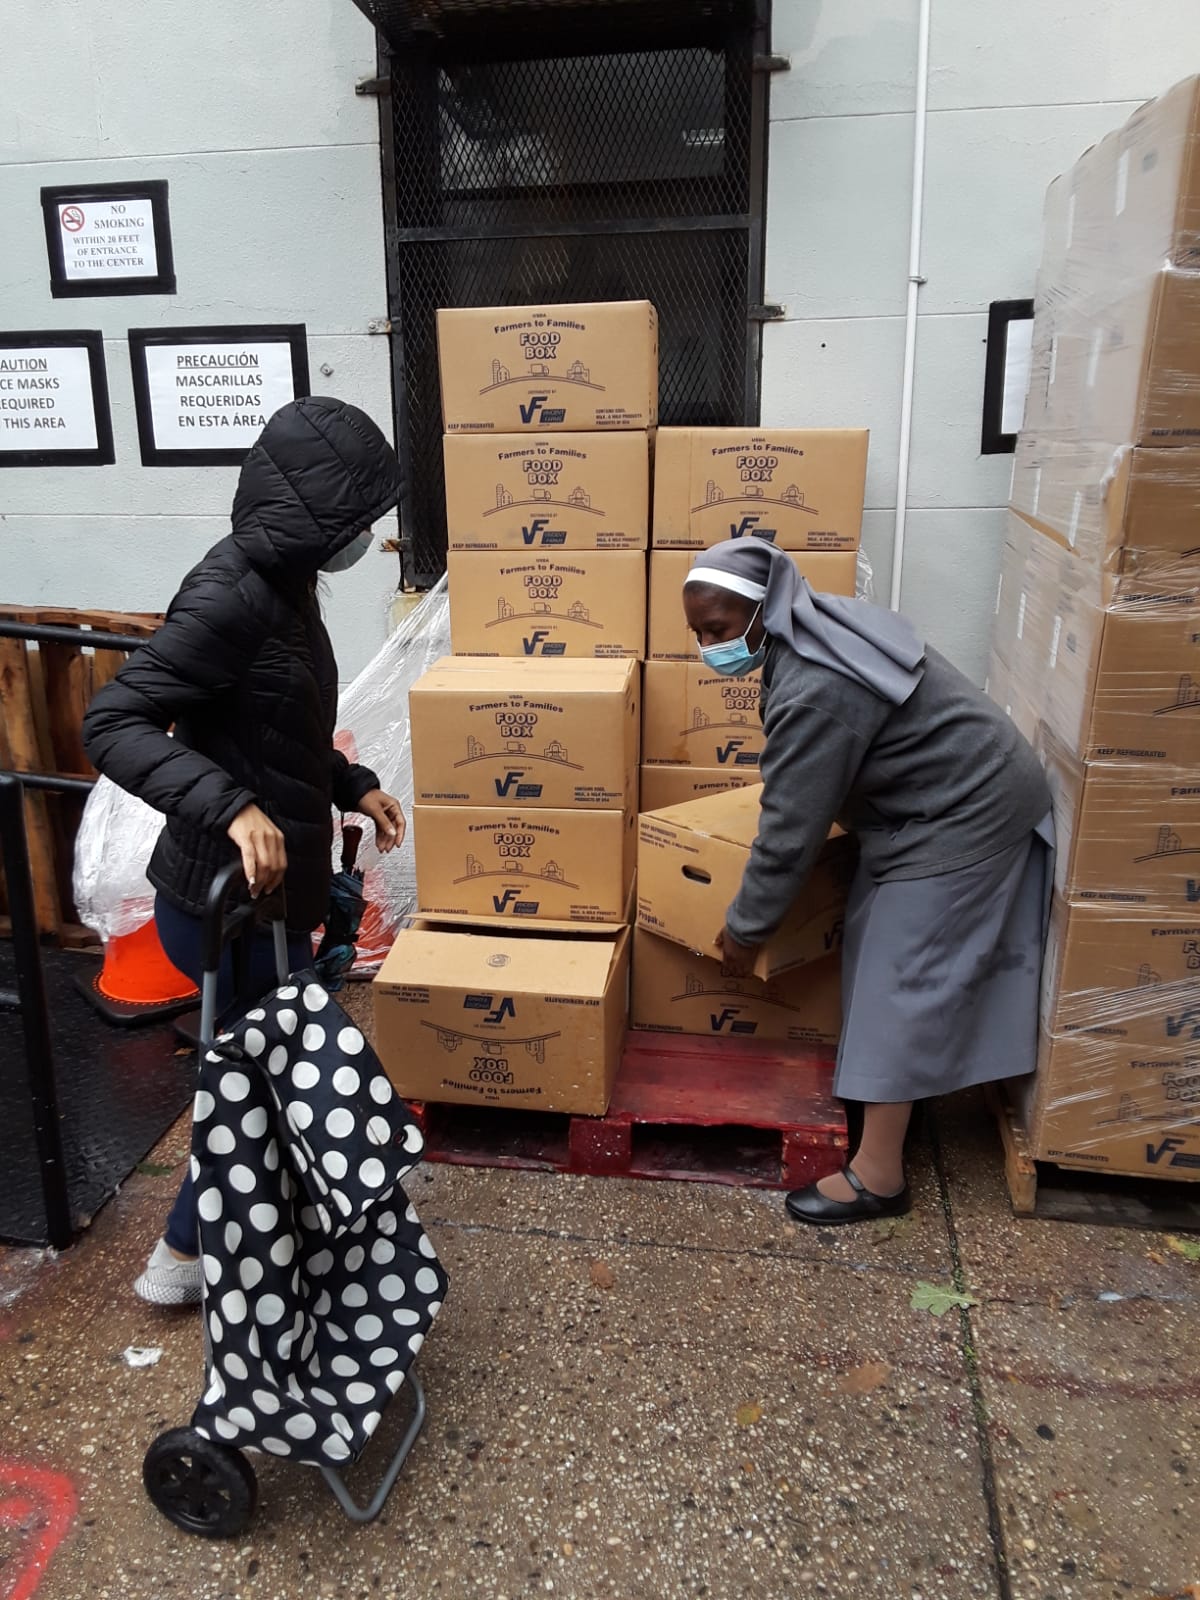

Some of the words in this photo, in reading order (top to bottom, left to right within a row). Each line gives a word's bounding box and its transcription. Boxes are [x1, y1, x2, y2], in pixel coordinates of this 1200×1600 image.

[110, 204, 126, 214] NO
[94, 218, 144, 229] SMOKING
[72, 236, 105, 245] WITHIN
[107, 235, 116, 244] 20
[118, 234, 140, 243] FEET
[77, 248, 88, 256] OF
[90, 246, 138, 256] ENTRANCE
[73, 260, 85, 268] TO
[86, 259, 105, 268] THE
[106, 258, 144, 267] CENTER
[494, 320, 532, 334] Farmers
[534, 319, 544, 328] to
[547, 318, 586, 331] Families
[519, 332, 561, 346] FOOD
[524, 346, 557, 360] BOX
[0, 358, 48, 372] AUTION
[176, 351, 259, 368] PRECAUCIÓN
[0, 379, 14, 390] CE
[17, 378, 60, 390] MASKS
[176, 374, 263, 387] MASCARILLAS
[0, 398, 55, 410] EQUIRED
[180, 394, 261, 408] REQUERIDAS
[3, 418, 30, 429] THIS
[34, 417, 66, 428] AREA
[178, 416, 195, 427] EN
[199, 415, 230, 427] ESTA
[232, 412, 266, 427] ÁREA
[498, 448, 534, 460] Farmers
[549, 447, 587, 460] Families
[712, 443, 750, 456] Farmers
[765, 444, 804, 456] Families
[522, 460, 562, 472] FOOD
[736, 456, 778, 469] FOOD
[528, 472, 558, 484] BOX
[740, 469, 772, 482] BOX
[500, 564, 536, 576] Farmers
[550, 564, 586, 575] Families
[524, 575, 562, 587] FOOD
[528, 587, 558, 599] BOX
[698, 676, 734, 686] Farmers
[721, 686, 760, 698] FOOD
[469, 701, 508, 713] Farmers
[510, 700, 521, 708] to
[523, 700, 564, 713] Families
[725, 698, 756, 710] BOX
[496, 712, 538, 725] FOOD
[500, 726, 534, 738] BOX
[1116, 748, 1166, 758] REFRIGERATED
[693, 782, 729, 790] Farmers
[1170, 787, 1200, 796] Farm
[468, 822, 507, 833] Farmers
[508, 822, 519, 830] to
[521, 822, 560, 835] Families
[494, 833, 535, 846] FOOD
[500, 846, 530, 858] BOX
[473, 1056, 508, 1072] BOX
[468, 1069, 514, 1084] FOOD
[1162, 1072, 1200, 1088] FOO
[442, 1078, 484, 1094] Families
[487, 1086, 497, 1094] to
